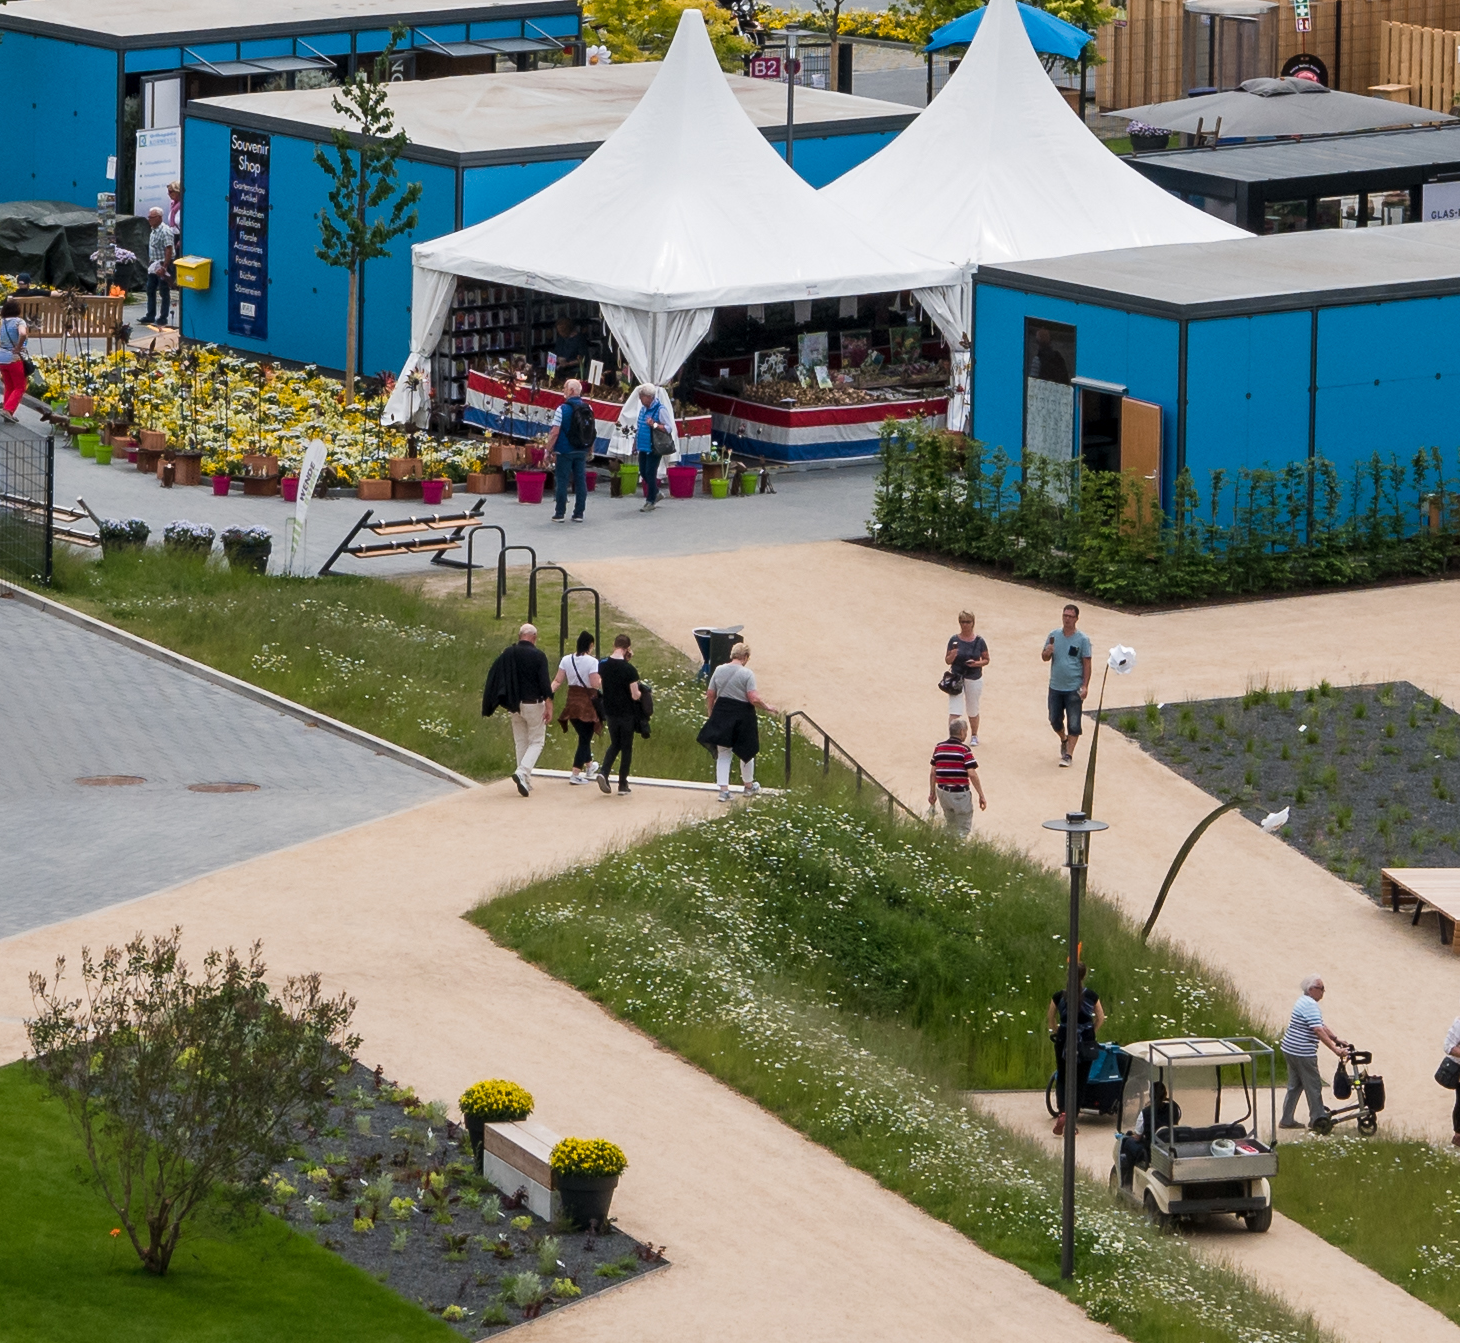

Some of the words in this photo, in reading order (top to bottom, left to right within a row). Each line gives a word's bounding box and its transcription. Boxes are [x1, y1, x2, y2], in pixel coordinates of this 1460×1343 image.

[755, 60, 777, 76] B2
[231, 134, 269, 155] Souvenir
[239, 154, 261, 177] Shop
[233, 180, 266, 195] Gartenschau
[241, 192, 257, 203] Artikel
[233, 206, 265, 219] Maskottchen
[236, 217, 261, 229] Kollektion
[239, 231, 257, 243] Florale
[234, 241, 263, 254] Accessoires
[235, 255, 261, 268] Postkarten
[239, 270, 257, 281] Bücher
[235, 283, 261, 296] Sämereien
[300, 461, 315, 501] WENDE
